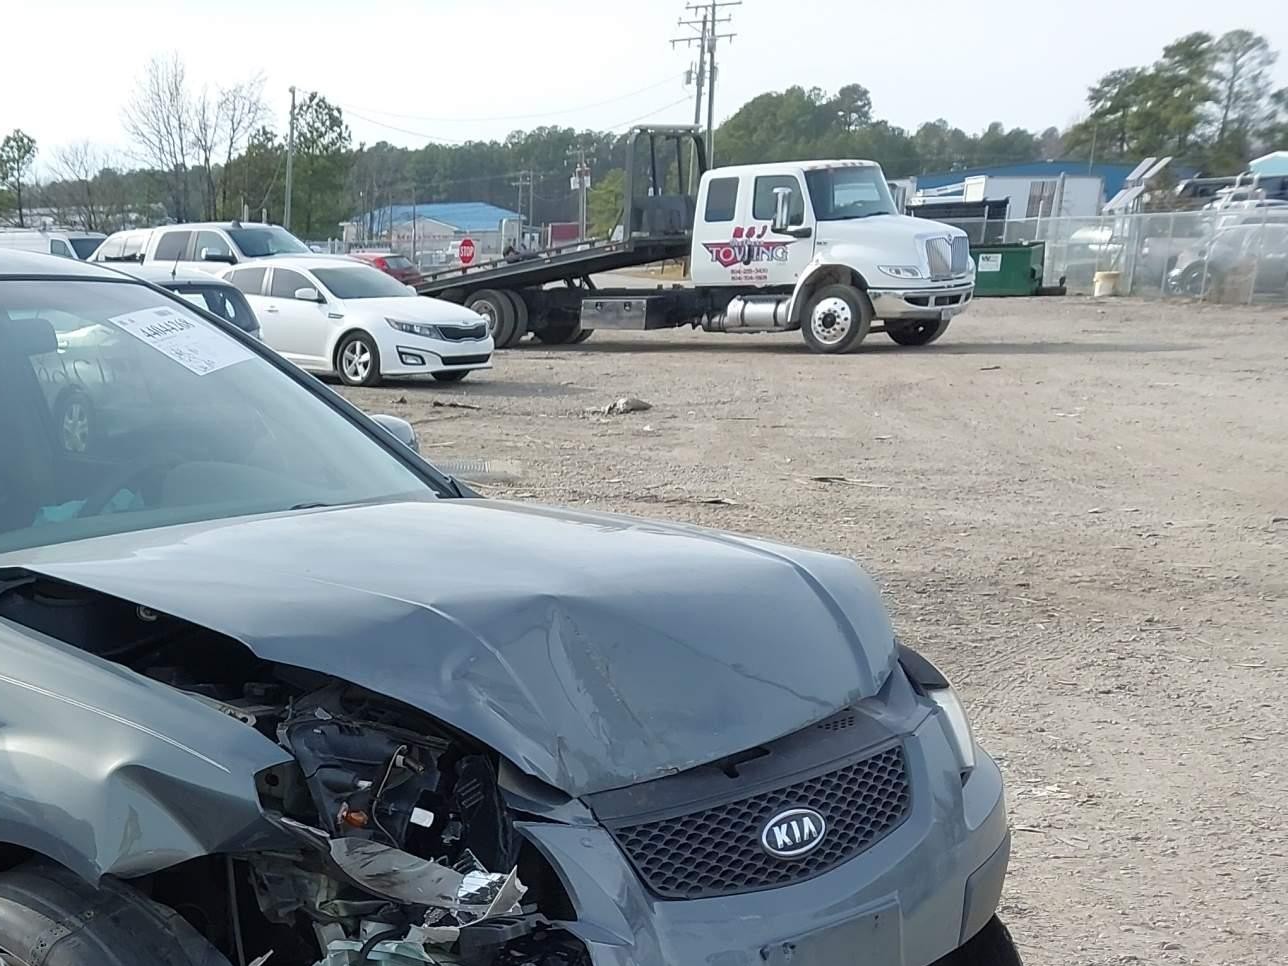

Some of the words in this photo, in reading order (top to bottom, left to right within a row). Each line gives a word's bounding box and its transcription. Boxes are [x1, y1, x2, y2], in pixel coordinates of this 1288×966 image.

[757, 225, 768, 239] J
[460, 245, 474, 257] STOP
[709, 246, 788, 262] TOWING
[772, 816, 818, 849] KIA
